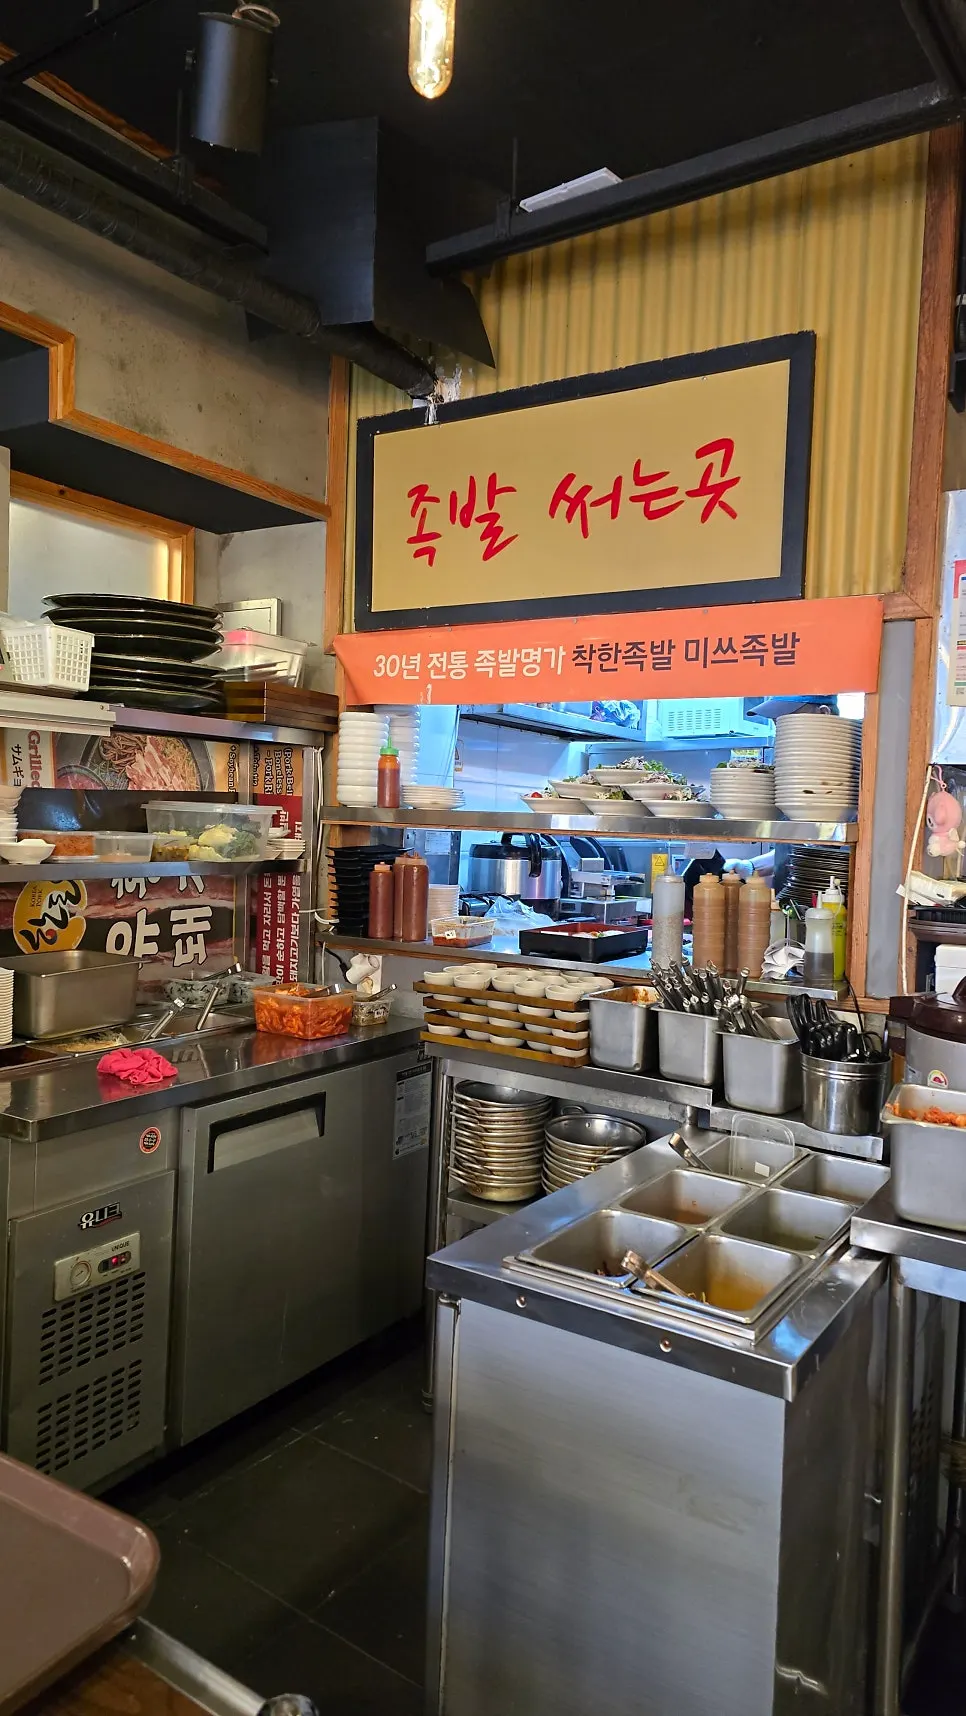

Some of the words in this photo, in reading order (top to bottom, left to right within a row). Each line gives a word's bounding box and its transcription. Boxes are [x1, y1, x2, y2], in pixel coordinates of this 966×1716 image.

[406, 471, 519, 568] 족발
[373, 652, 421, 680] 30년
[427, 650, 469, 680] 전통
[474, 645, 566, 679] 족발명가
[571, 639, 676, 674] 착한족발
[684, 631, 801, 669] 미쓰족발
[228, 752, 236, 788] Soybean
[265, 758, 273, 782] Pork
[274, 750, 284, 795] Boneless
[29, 885, 37, 908] KOREA
[263, 891, 272, 926] 자라서
[276, 927, 285, 961] 순하고
[289, 912, 300, 982] 돼지고기보다
[80, 1203, 120, 1229] 유니크
[111, 1241, 130, 1252] UNIQUE
